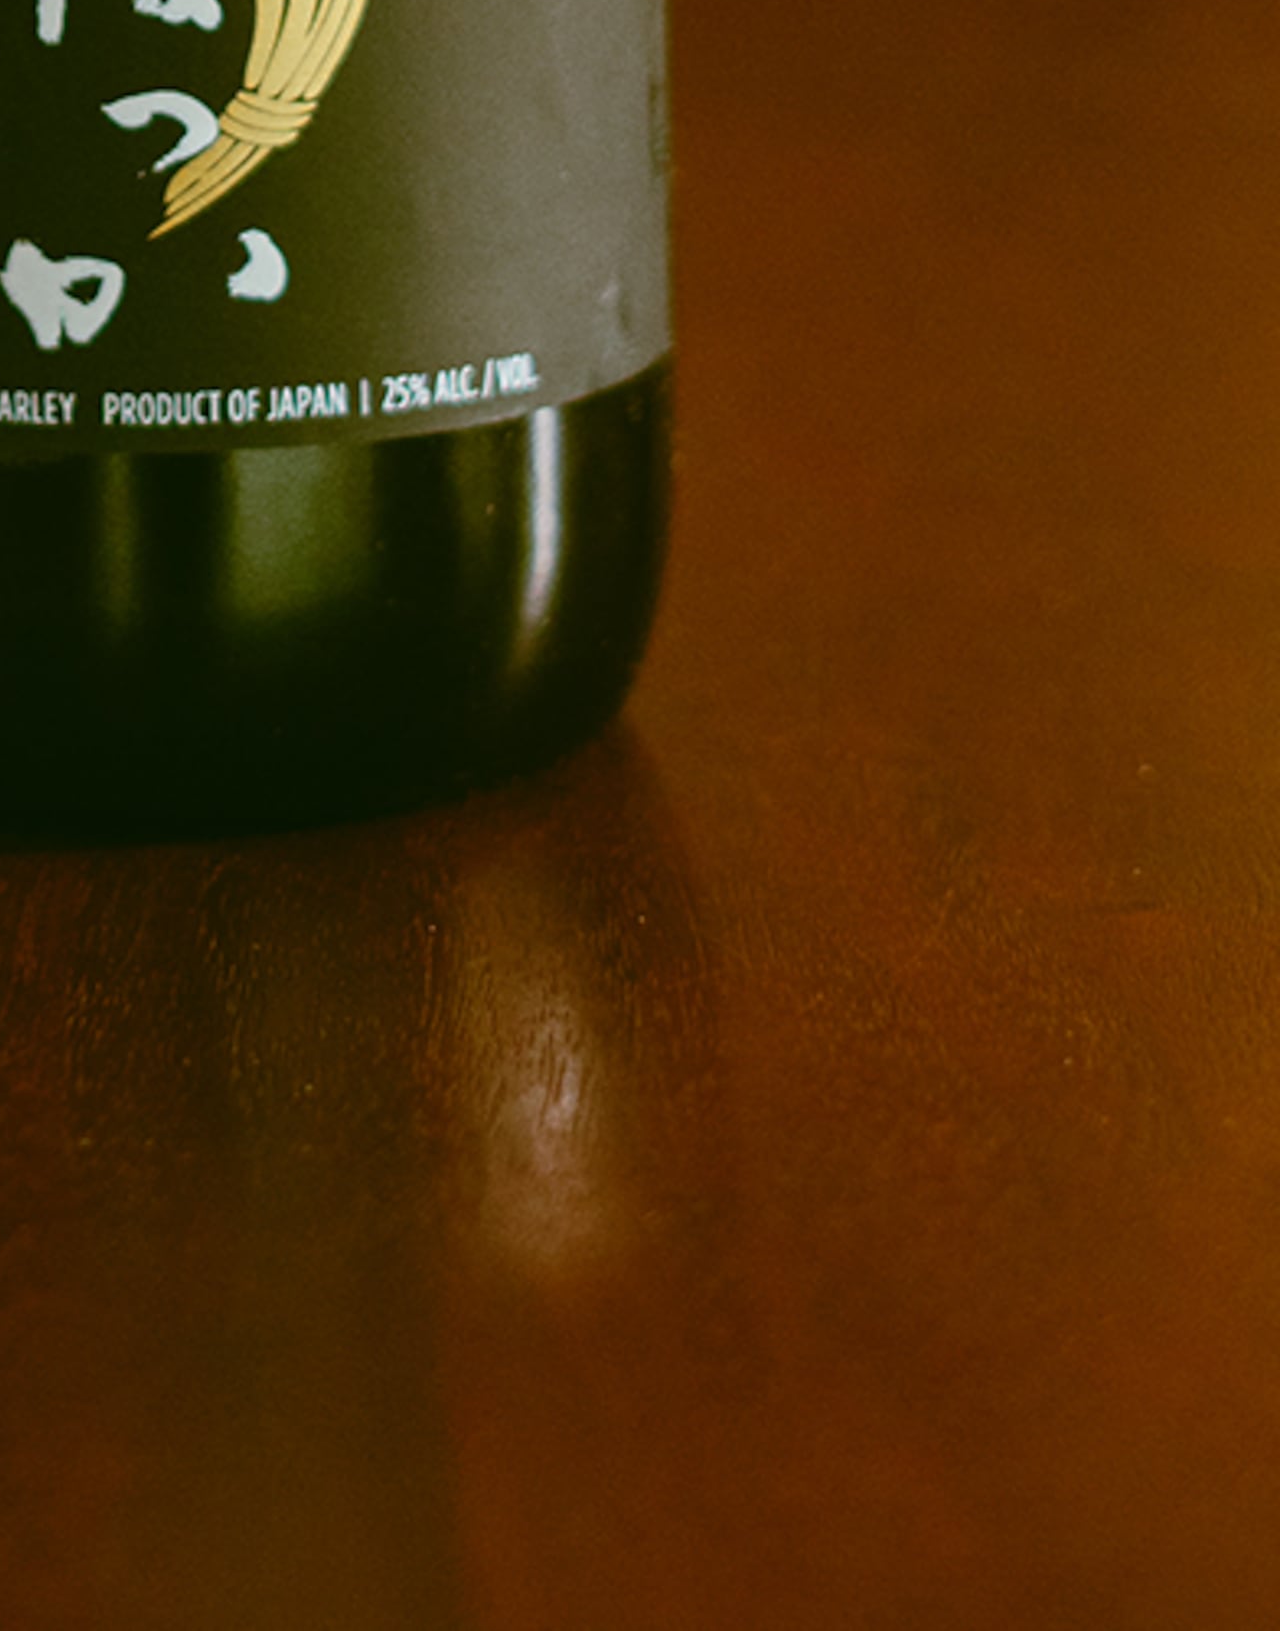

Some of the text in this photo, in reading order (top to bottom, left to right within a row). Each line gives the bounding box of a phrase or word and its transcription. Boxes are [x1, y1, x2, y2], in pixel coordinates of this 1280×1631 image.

[102, 389, 222, 426] PRODUCT
[227, 387, 261, 424] OF
[265, 381, 349, 423] JAPAN
[381, 372, 430, 412] 25%
[433, 363, 477, 405] ALC.
